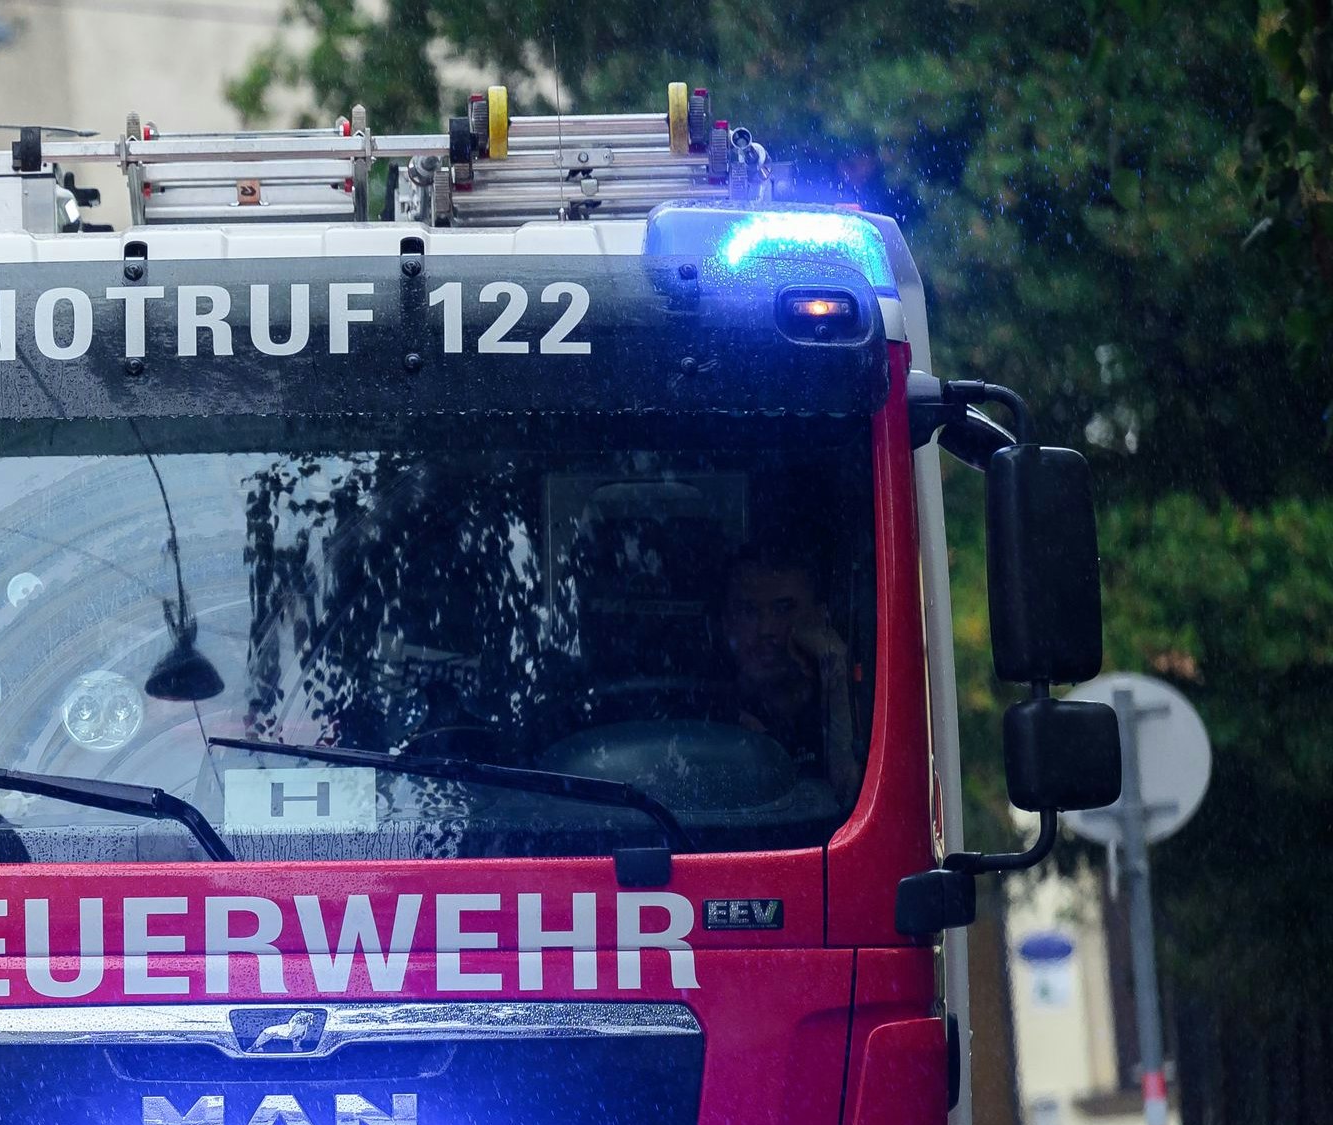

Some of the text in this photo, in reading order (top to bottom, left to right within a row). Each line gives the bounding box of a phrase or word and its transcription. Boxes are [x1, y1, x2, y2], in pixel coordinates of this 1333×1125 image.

[428, 280, 593, 355] 122
[270, 781, 331, 818] H
[707, 900, 779, 924] EEV
